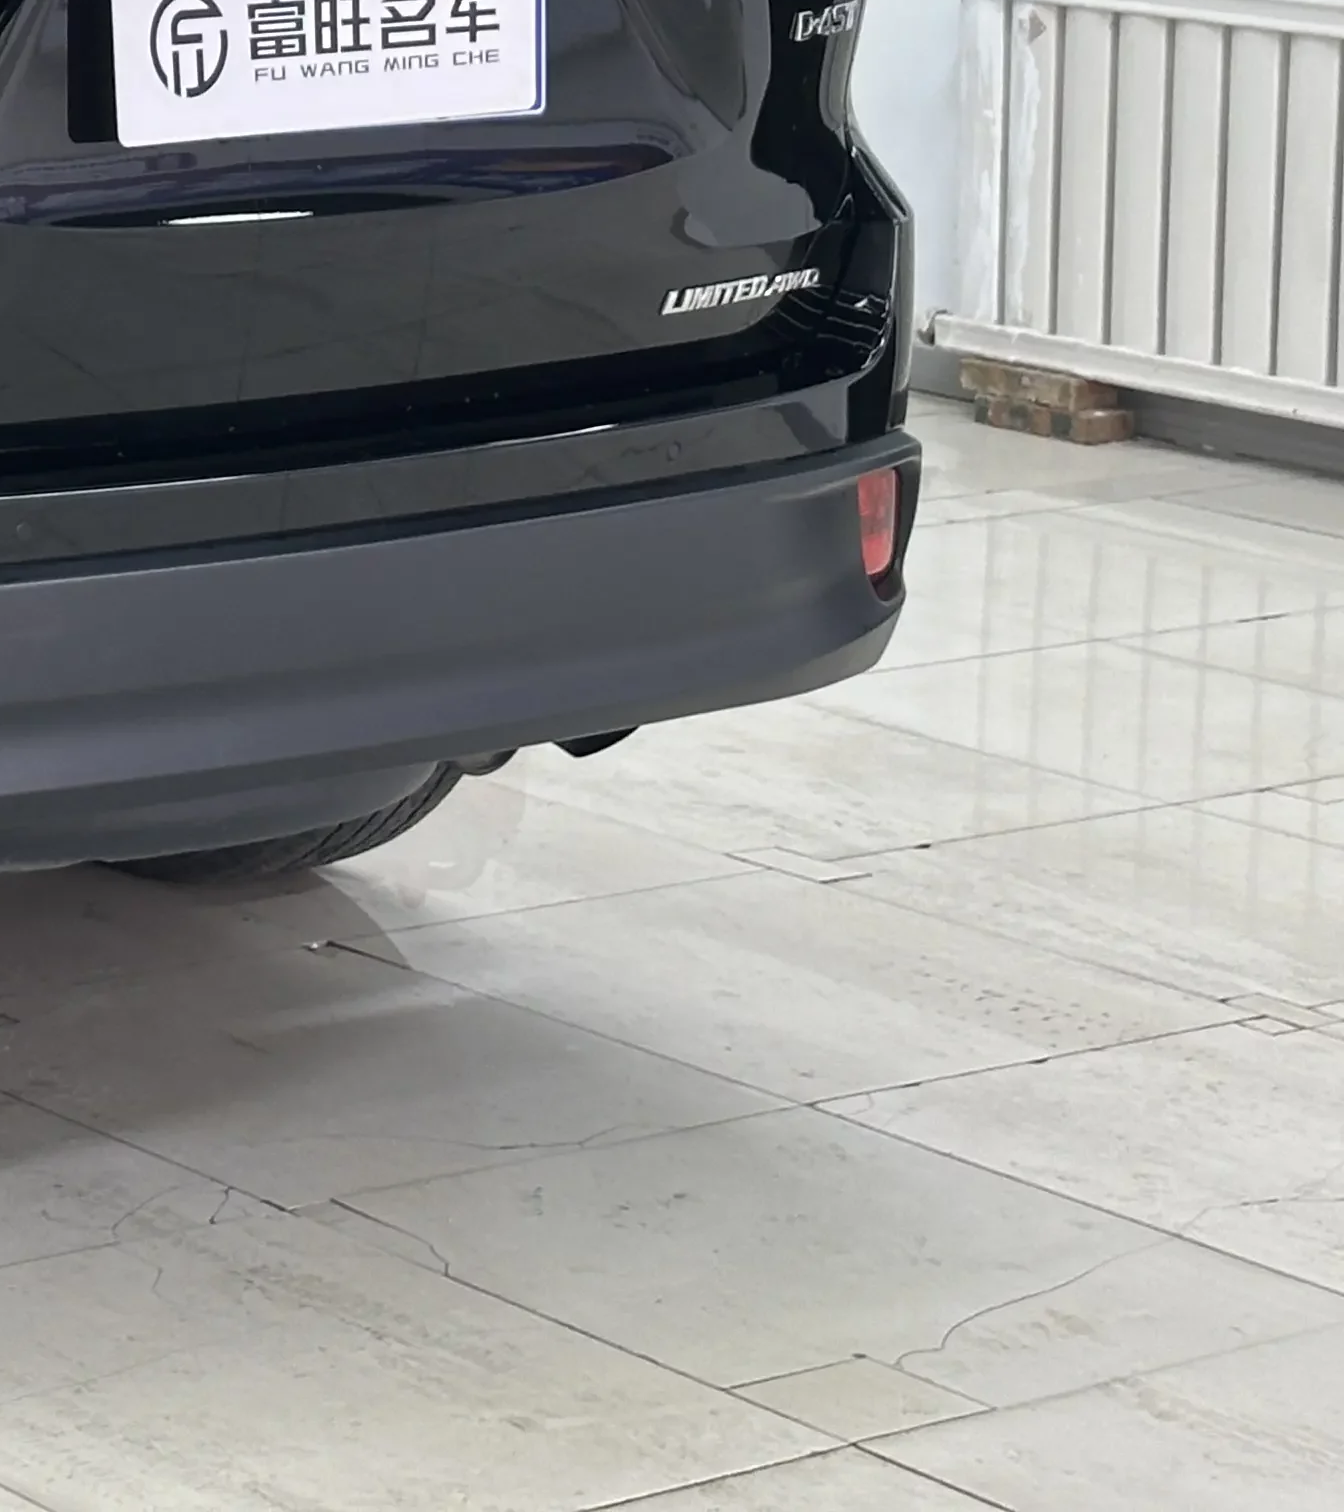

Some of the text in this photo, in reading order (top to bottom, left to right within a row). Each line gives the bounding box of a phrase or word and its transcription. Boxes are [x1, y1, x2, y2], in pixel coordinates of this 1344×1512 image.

[254, 48, 500, 83] FU WANG MING CHE
[661, 274, 769, 316] LIMITED
